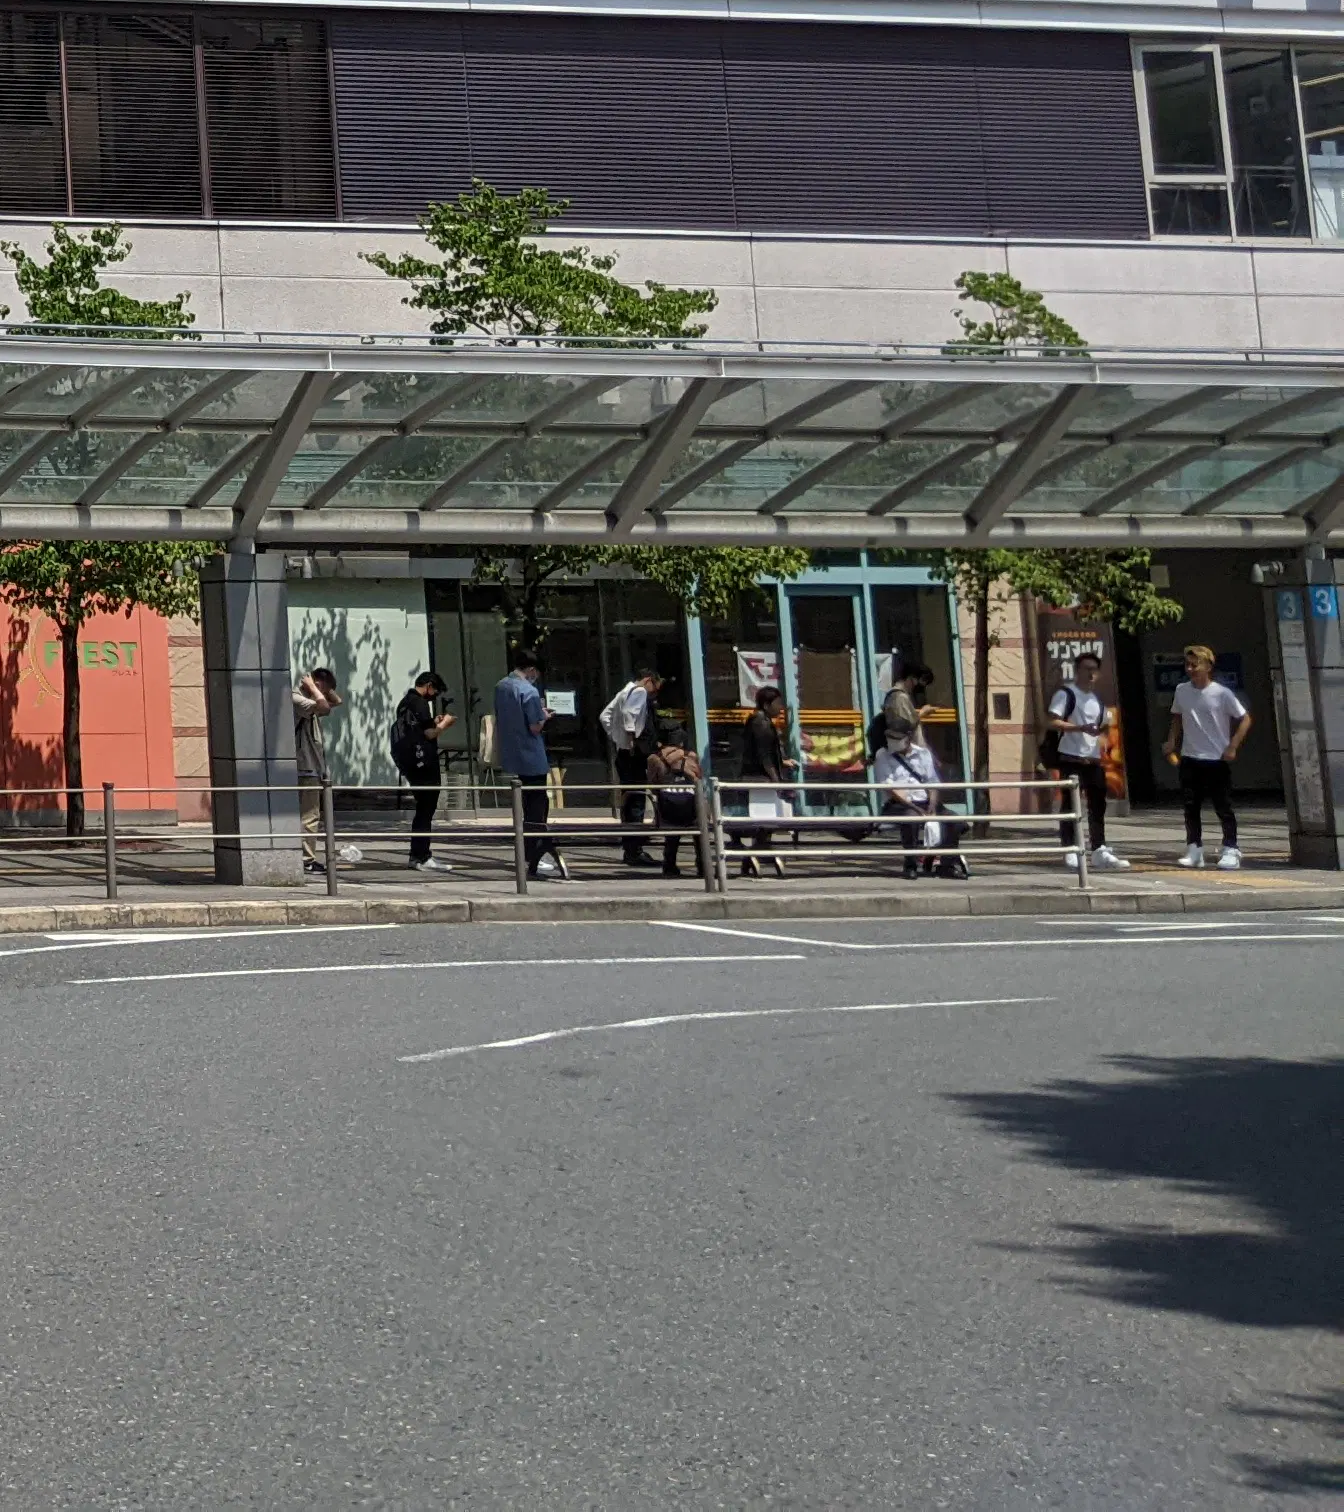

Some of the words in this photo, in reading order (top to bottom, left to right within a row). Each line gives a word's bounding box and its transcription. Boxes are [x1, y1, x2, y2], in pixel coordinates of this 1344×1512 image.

[1282, 592, 1297, 619] 3
[1315, 589, 1332, 615] 3
[43, 640, 138, 669] FEST
